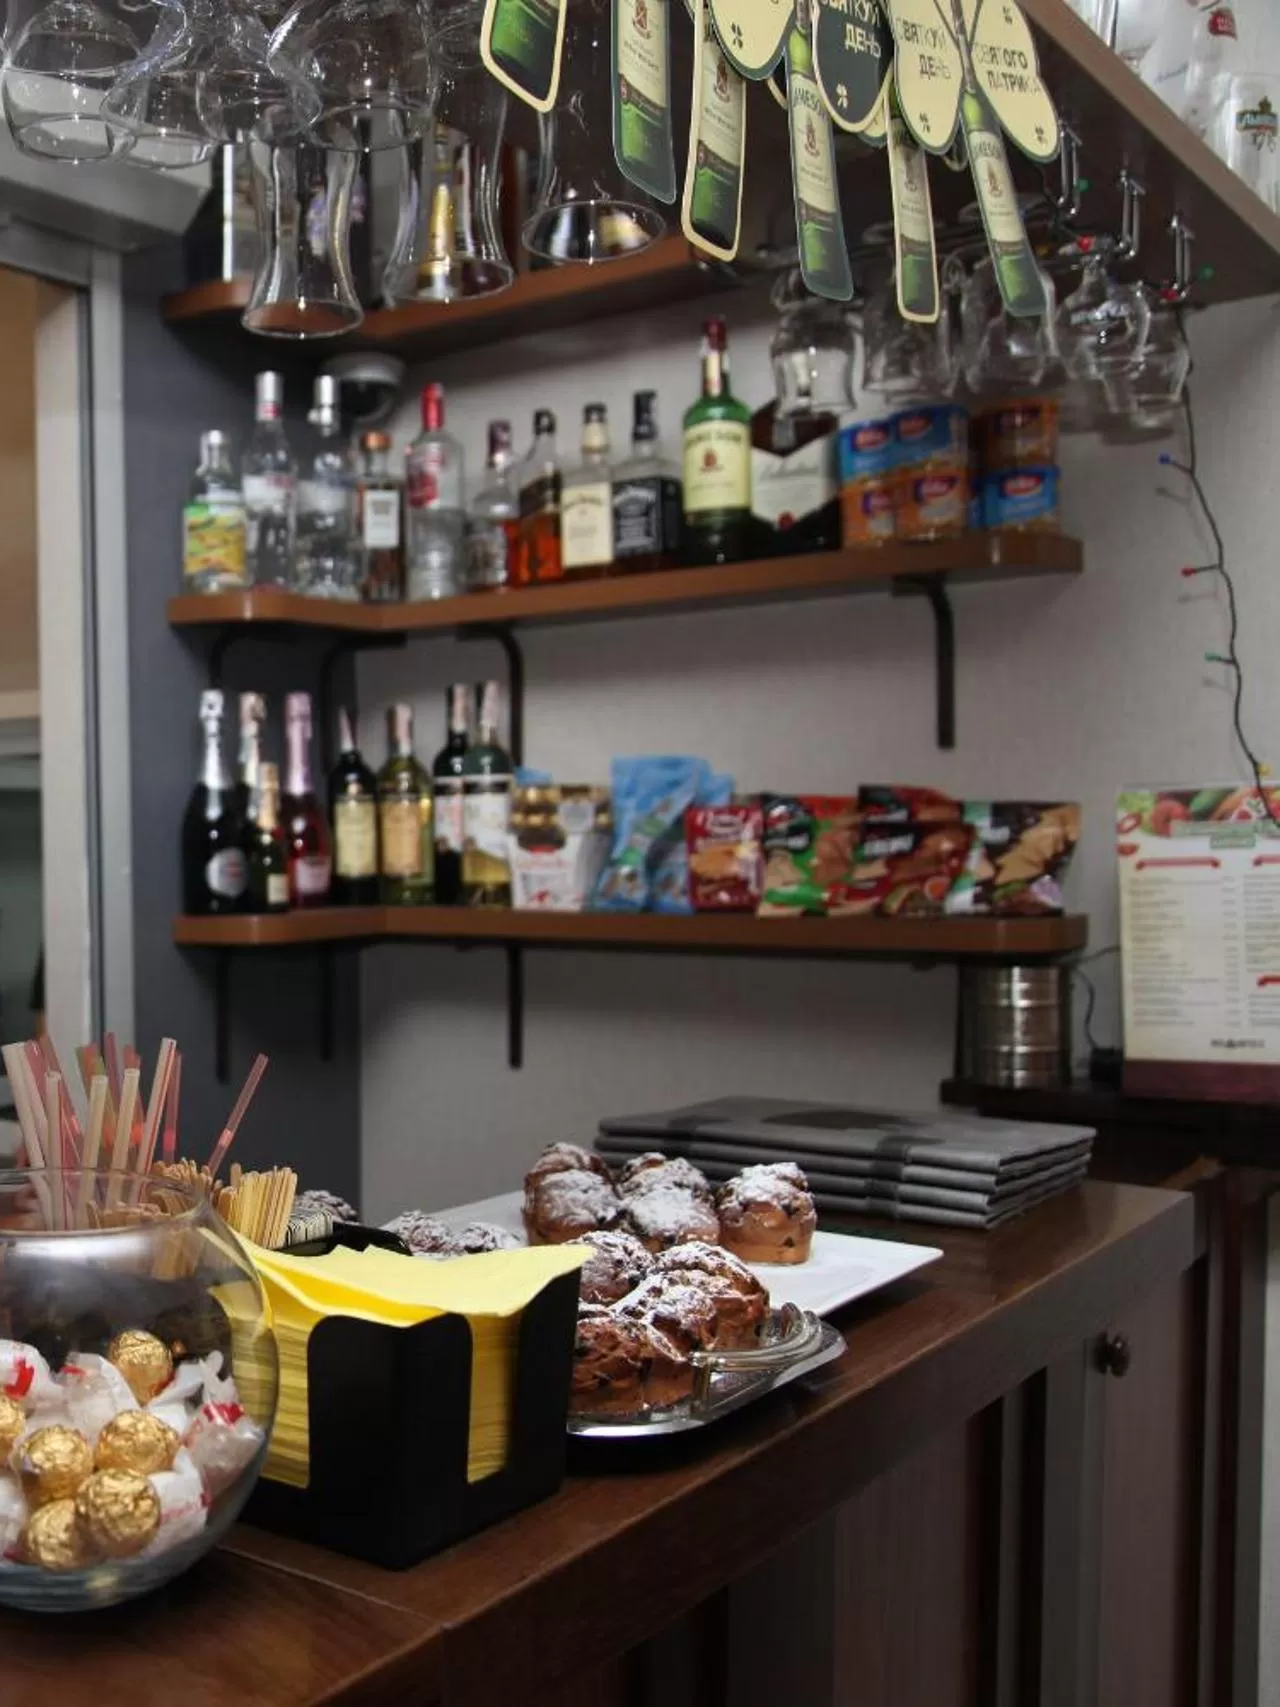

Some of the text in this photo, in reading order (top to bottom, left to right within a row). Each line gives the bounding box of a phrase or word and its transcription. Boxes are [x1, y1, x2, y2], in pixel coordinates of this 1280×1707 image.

[821, 0, 881, 28] ЯТКУЙ
[845, 23, 881, 58] ДЕНЬ
[919, 54, 952, 80] ДЕНЬ
